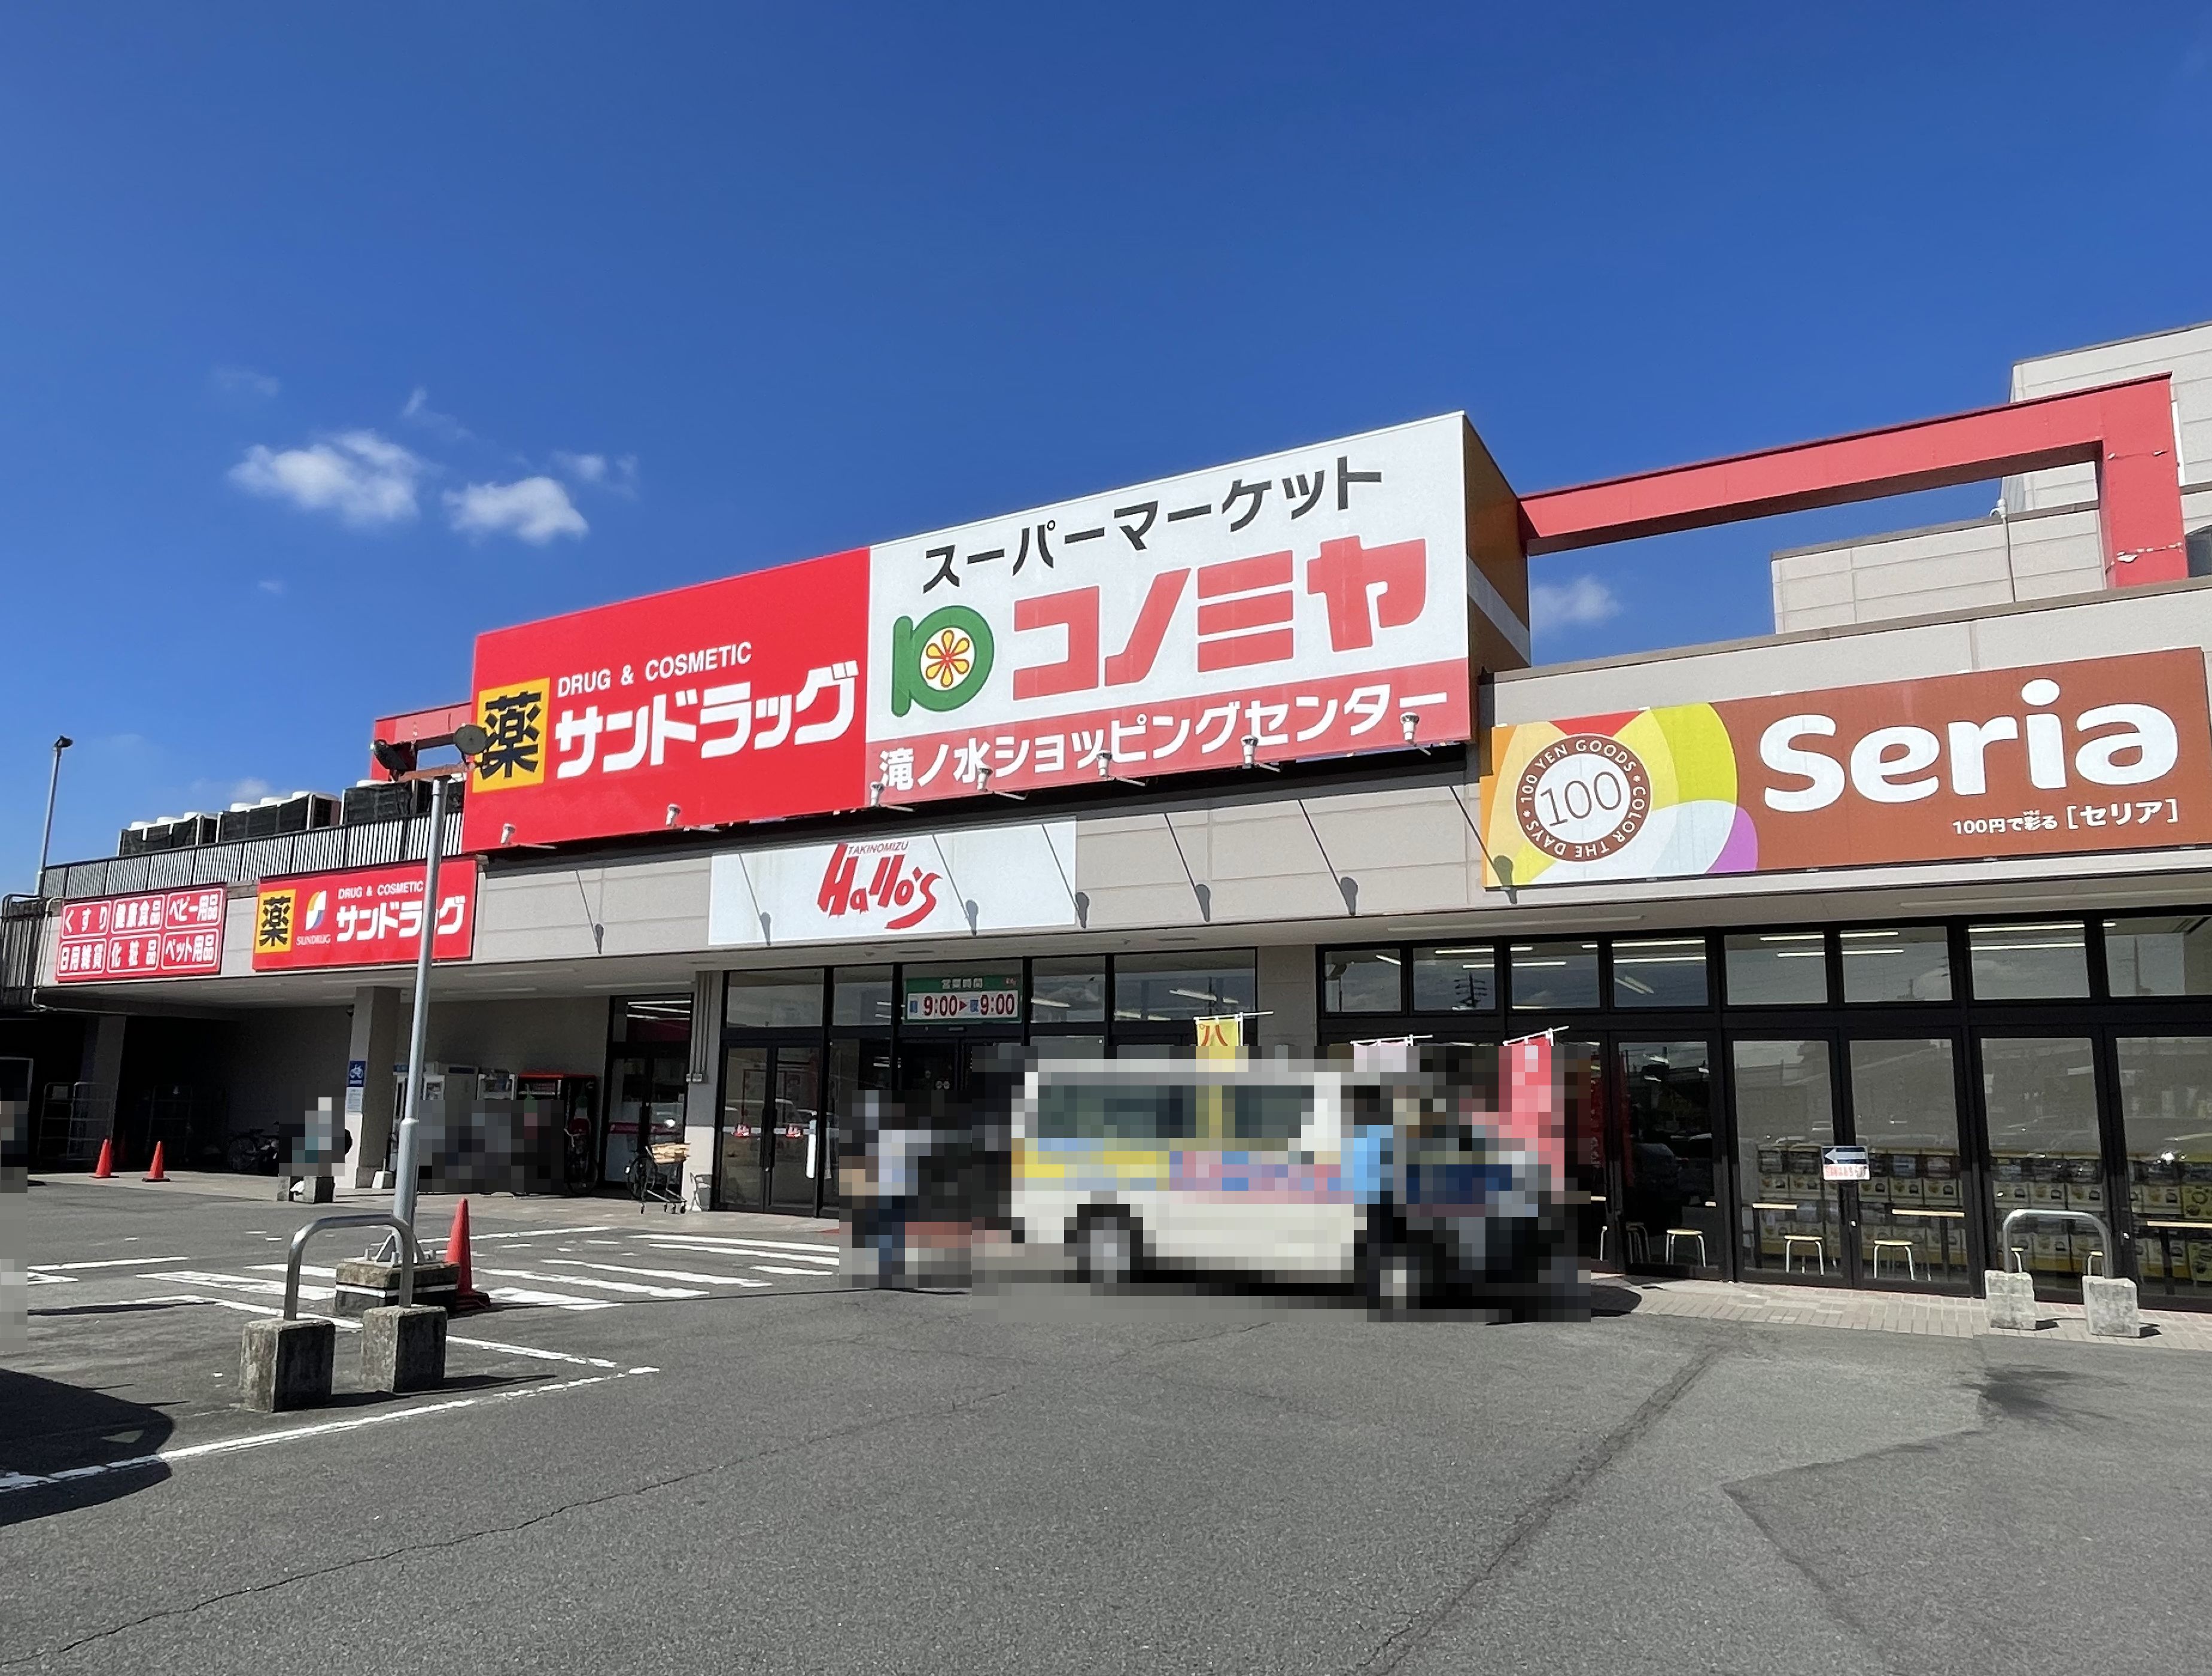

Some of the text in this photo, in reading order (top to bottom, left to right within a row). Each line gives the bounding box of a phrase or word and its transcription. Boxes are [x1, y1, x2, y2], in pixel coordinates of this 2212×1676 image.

[923, 456, 1381, 593] スーパーマーケット
[1014, 536, 1426, 700] コノミヤ
[558, 642, 752, 698] DRUG & COSMETIC
[481, 691, 542, 780] 薬
[555, 660, 859, 779] サンドラッグ
[879, 683, 1447, 790] 滝ノ水ショッピングセンター
[1535, 744, 1568, 769] YEN
[1576, 740, 1636, 772] GOODS
[1526, 786, 1646, 857] COLOR THE DAYS
[1540, 771, 1622, 827] 100
[848, 841, 908, 854] TAKINOMIZU
[338, 880, 424, 899] DRUG & COSMETIC
[817, 842, 943, 929] Hallo's
[66, 906, 108, 933] くすり
[259, 896, 291, 947] 薬
[336, 895, 466, 942] サンドラグ
[923, 995, 958, 1016] 9:00
[980, 993, 1015, 1016] 9:00
